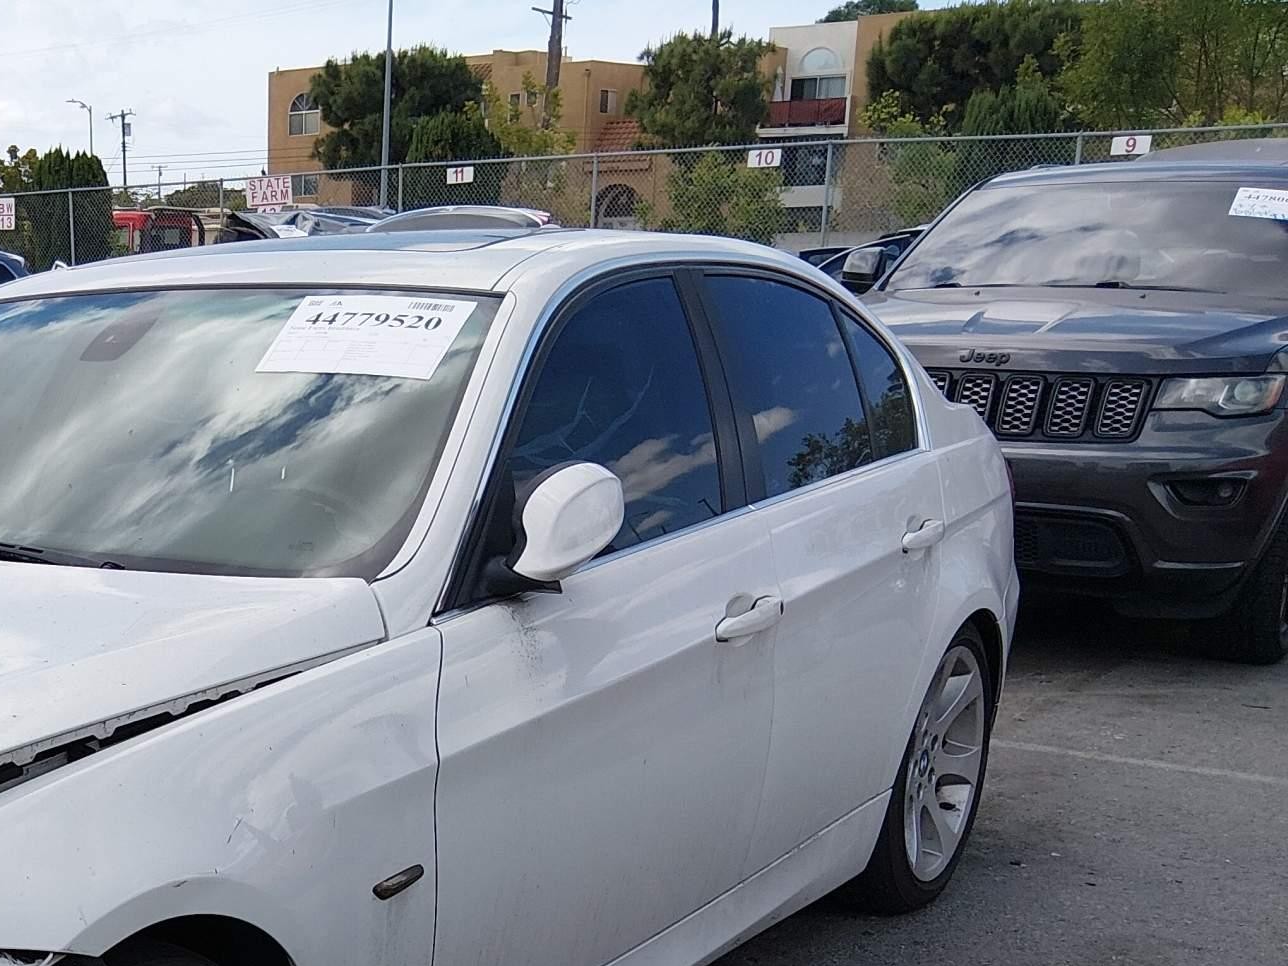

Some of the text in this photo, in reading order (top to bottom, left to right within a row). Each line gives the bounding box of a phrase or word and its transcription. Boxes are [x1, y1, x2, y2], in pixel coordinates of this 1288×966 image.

[1125, 137, 1137, 153] 9
[755, 150, 775, 166] 10
[452, 167, 464, 182] 11
[249, 176, 290, 191] STATE
[251, 189, 289, 203] FARM
[0, 217, 13, 229] 13
[305, 311, 443, 330] 44779520
[959, 348, 1011, 367] Jeep
